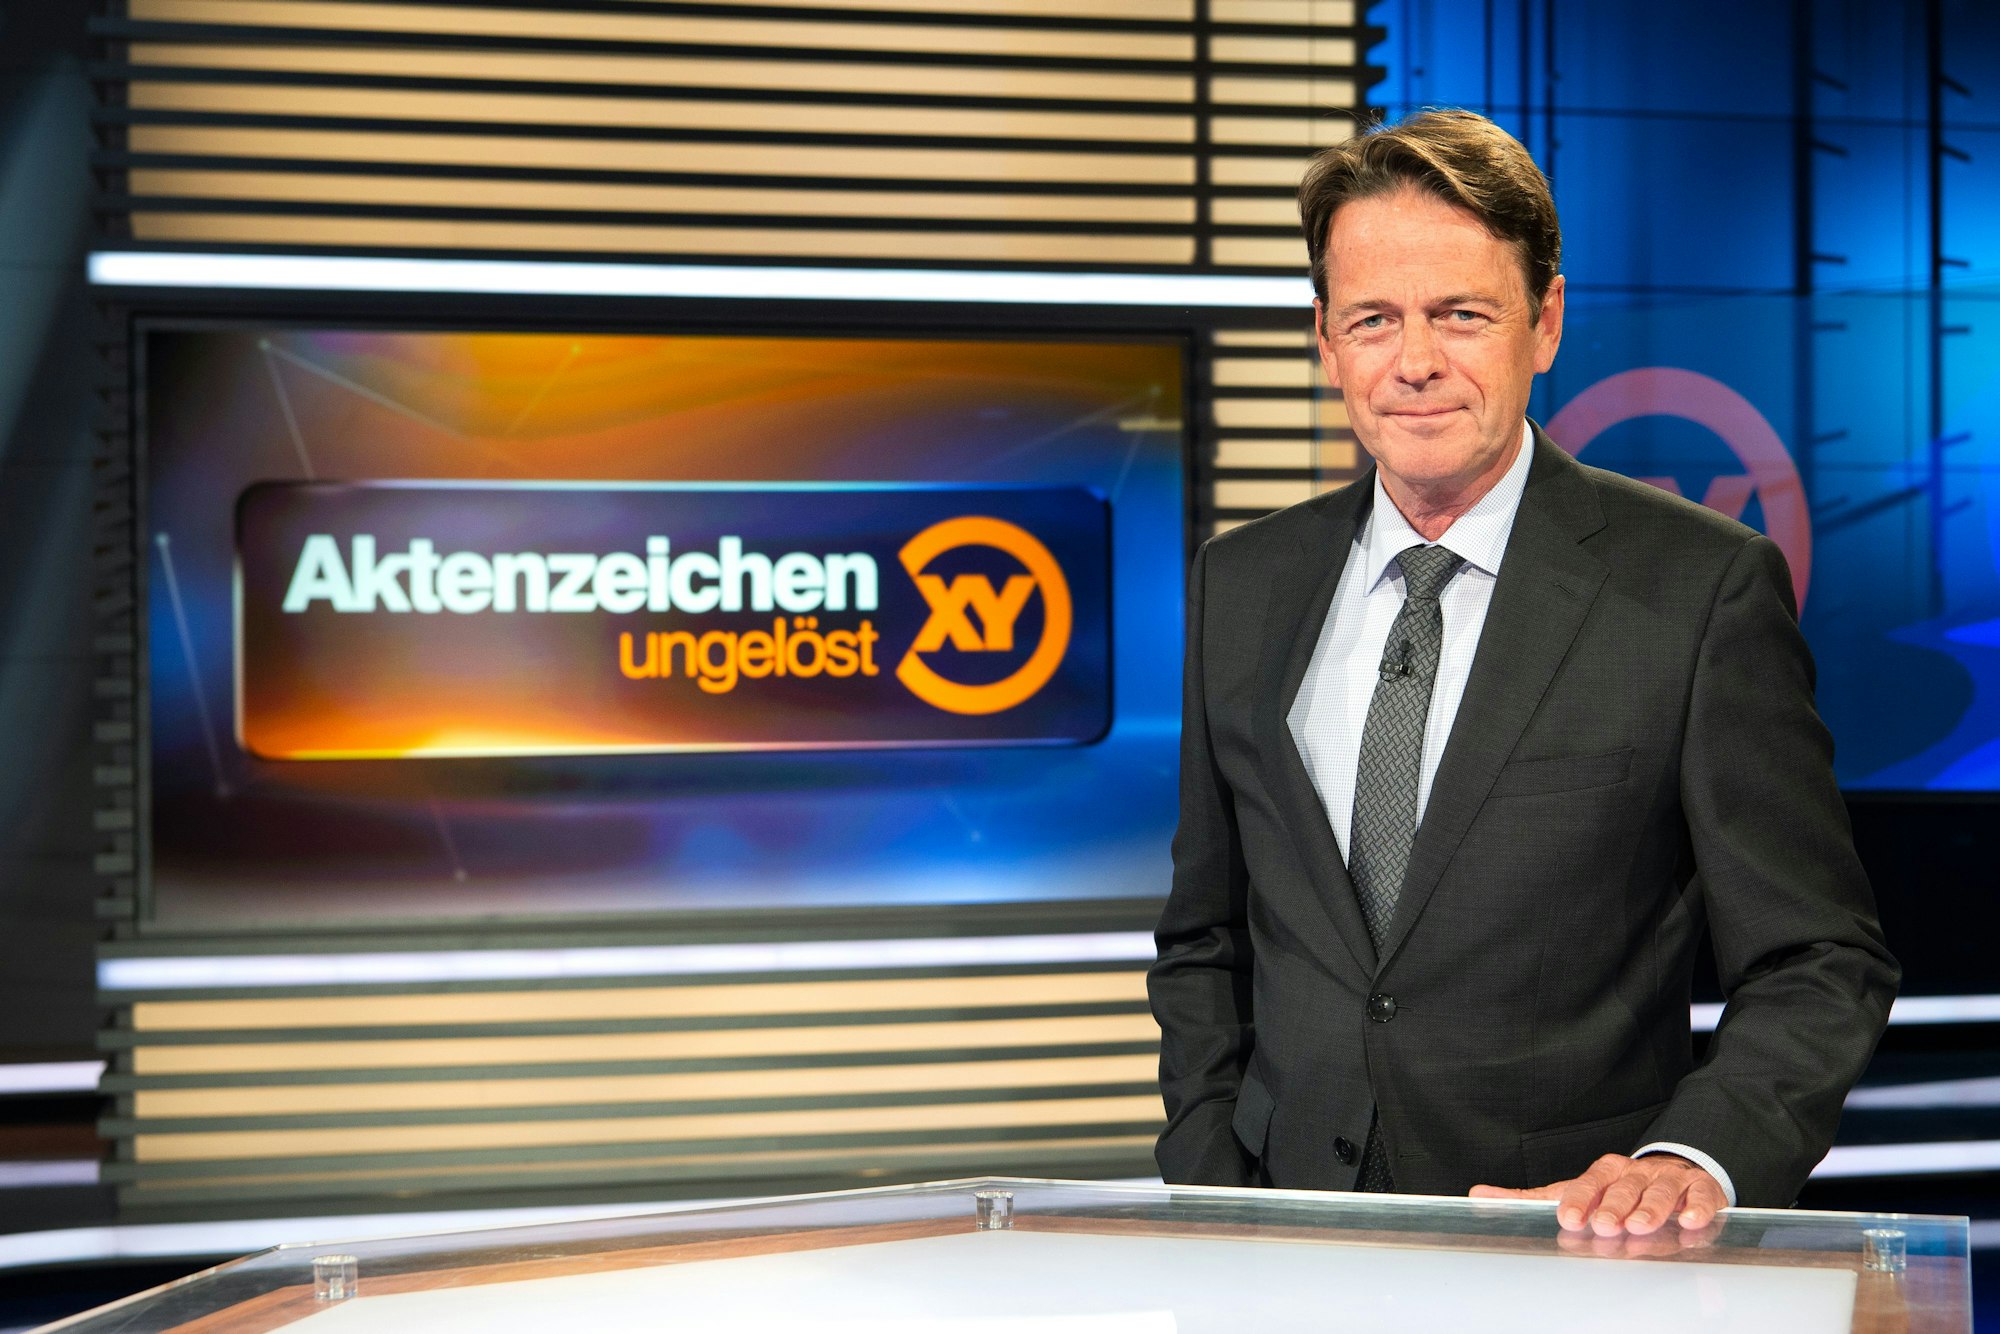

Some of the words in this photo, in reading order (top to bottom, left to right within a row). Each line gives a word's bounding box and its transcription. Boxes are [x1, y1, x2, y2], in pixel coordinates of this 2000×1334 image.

[283, 534, 879, 613] Aktenzeichen
[914, 575, 1036, 651] XY
[620, 617, 879, 694] ungelöst
